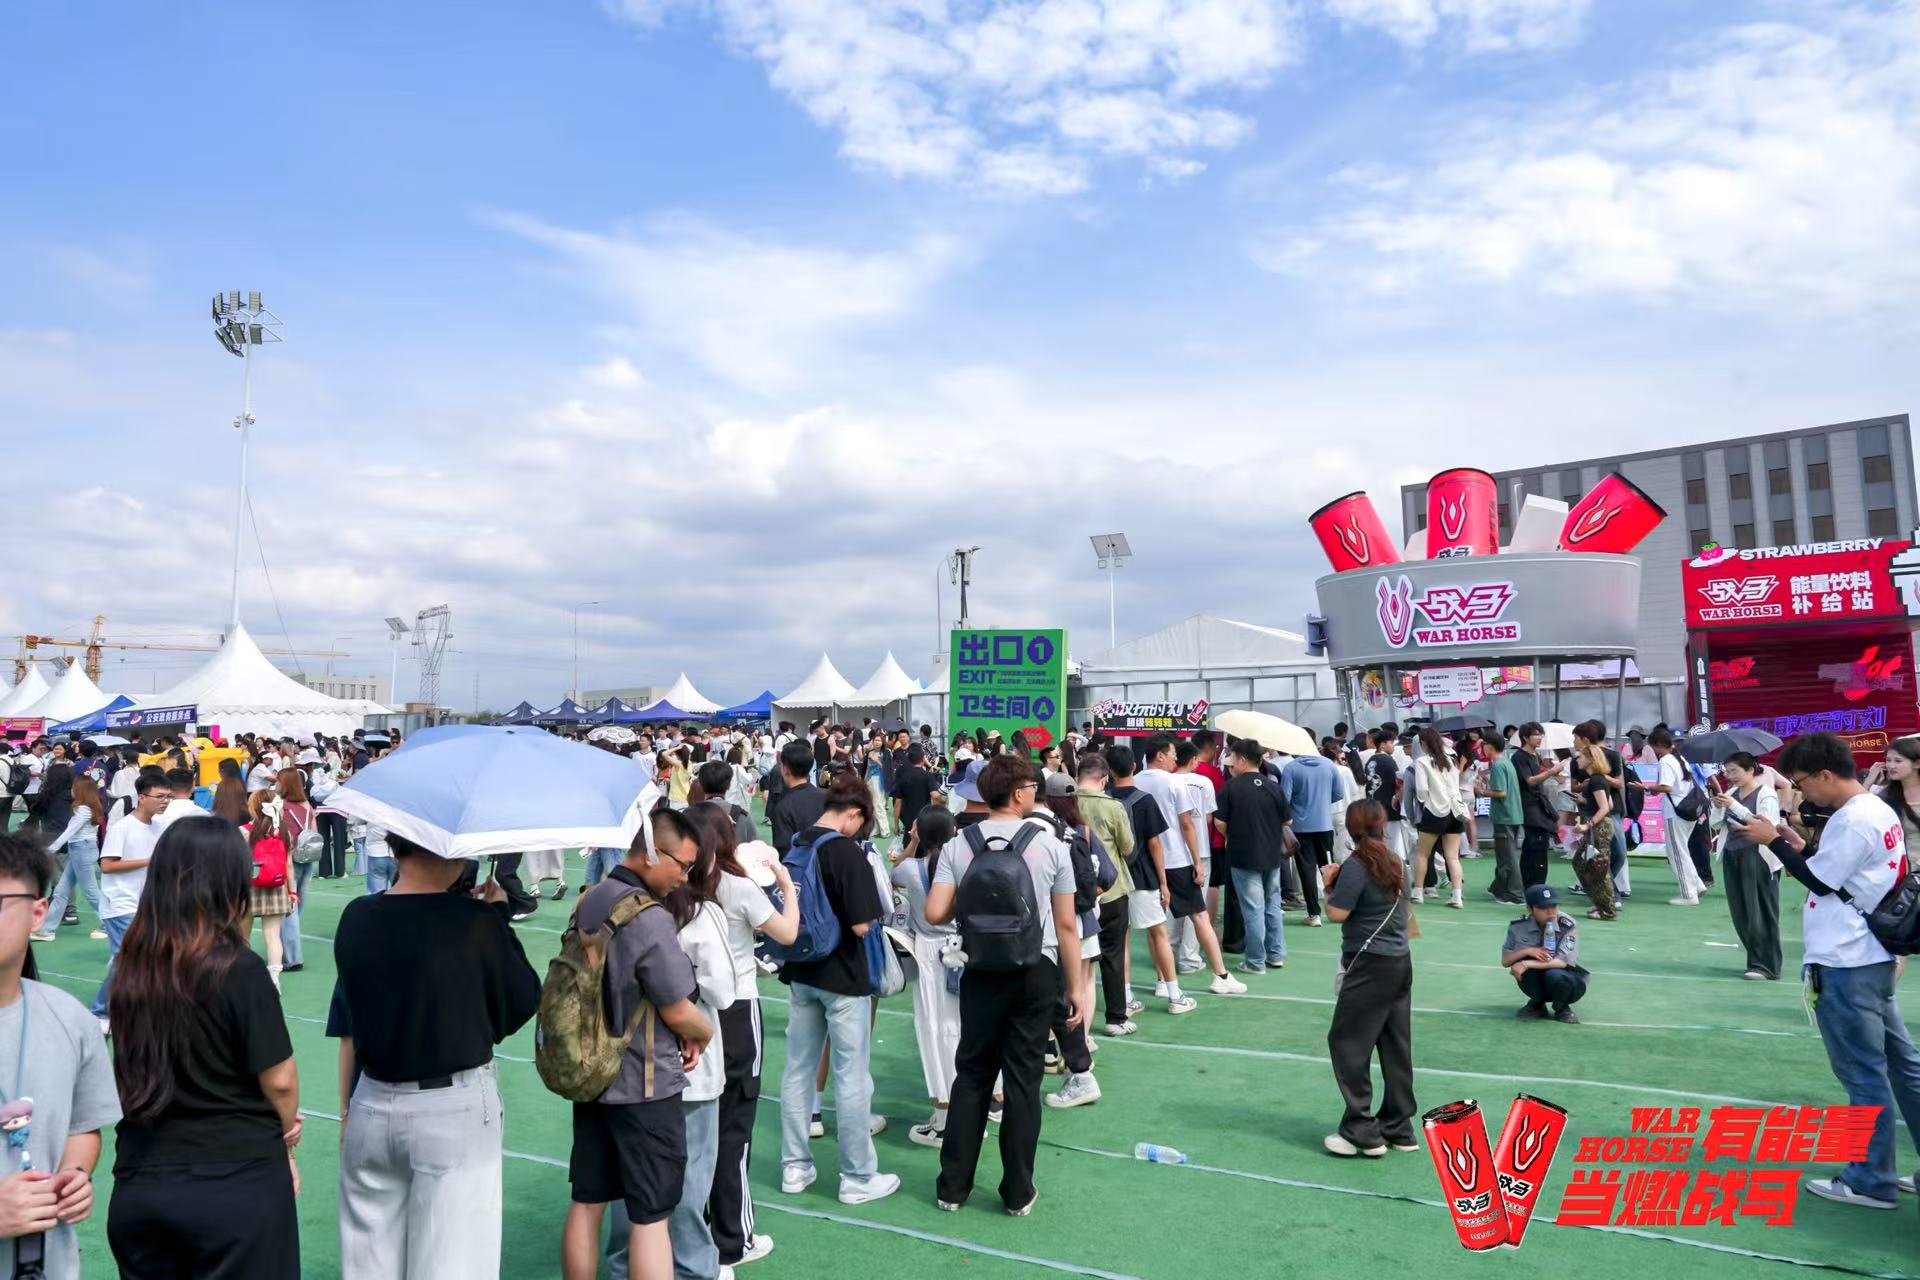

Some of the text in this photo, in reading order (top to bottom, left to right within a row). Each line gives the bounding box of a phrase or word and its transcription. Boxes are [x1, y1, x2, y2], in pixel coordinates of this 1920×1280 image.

[1739, 537, 1884, 561] STRAWBERRY
[1790, 571, 1872, 594] 能量饮料
[1701, 605, 1781, 620] WAR HORSE
[1792, 592, 1874, 614] 补给站
[1416, 625, 1518, 644] WAR HORSE
[959, 634, 1024, 665] 出口
[959, 669, 996, 684] EXIT
[957, 695, 1030, 720] 卫生间
[1849, 738, 1883, 748] HORSE
